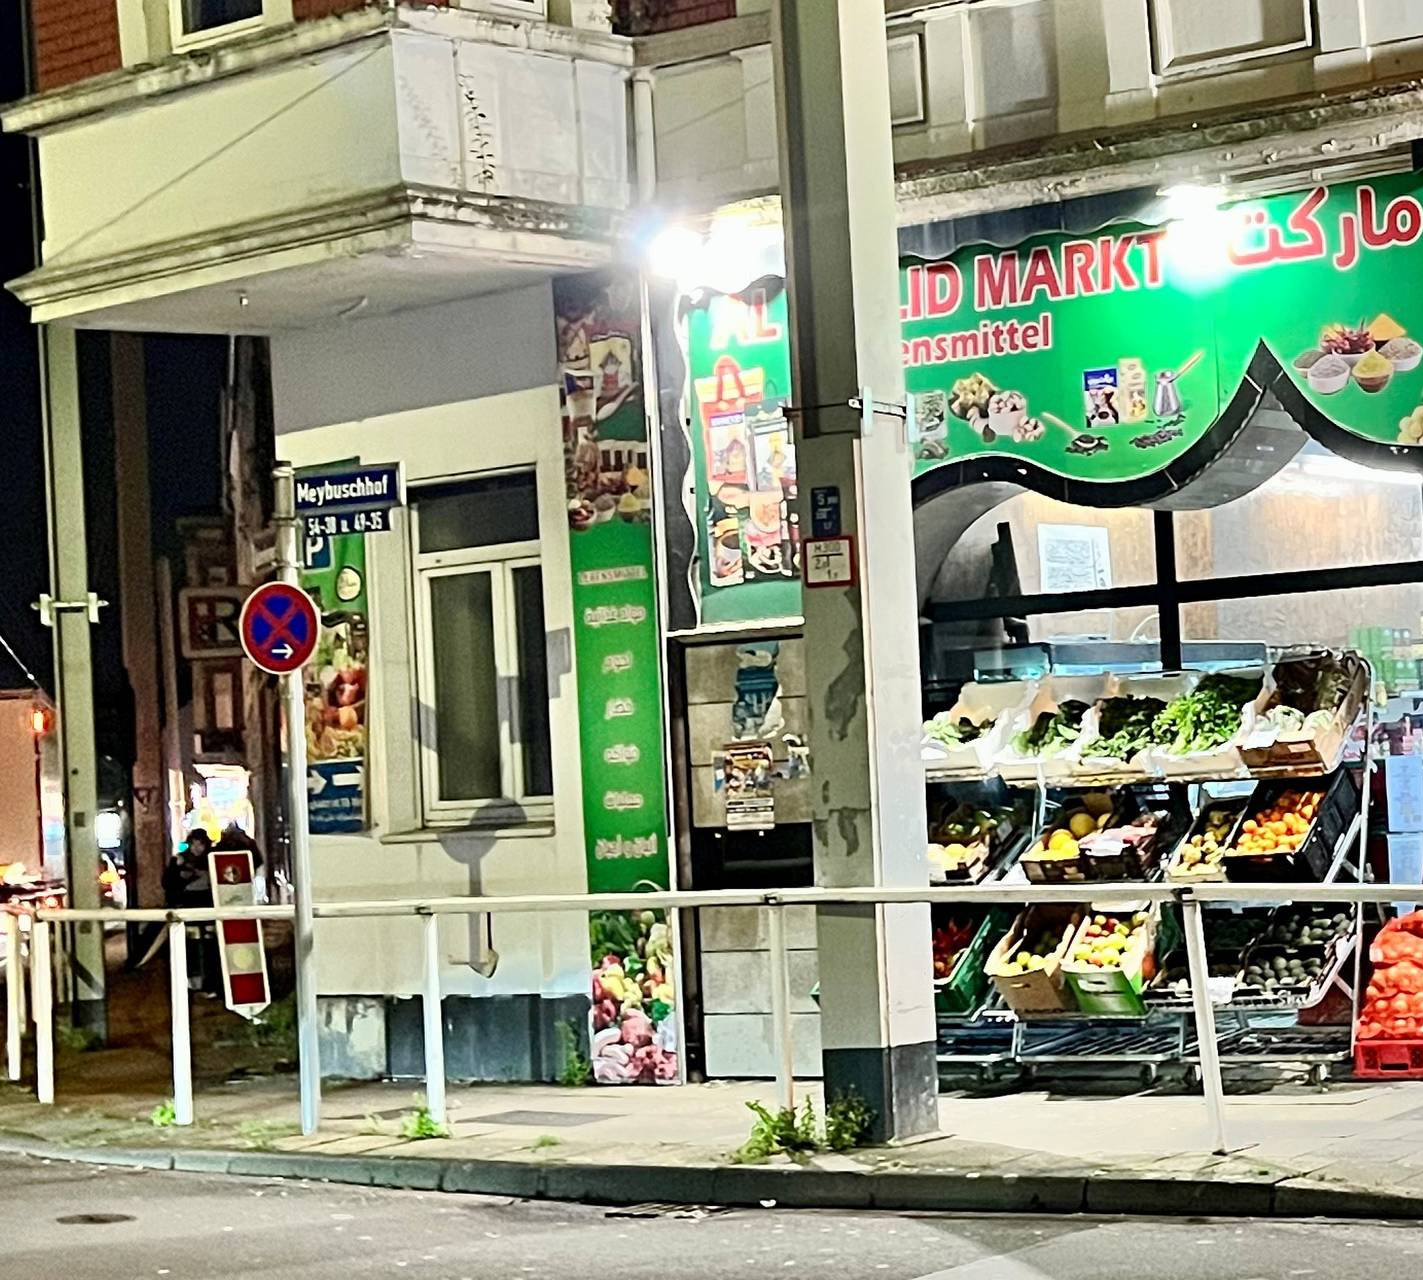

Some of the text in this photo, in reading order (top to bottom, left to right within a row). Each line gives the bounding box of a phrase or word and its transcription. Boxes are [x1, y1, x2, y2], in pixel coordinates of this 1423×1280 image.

[975, 228, 1172, 312] MARKT
[296, 474, 389, 507] Meybuschhof
[305, 536, 325, 567] P
